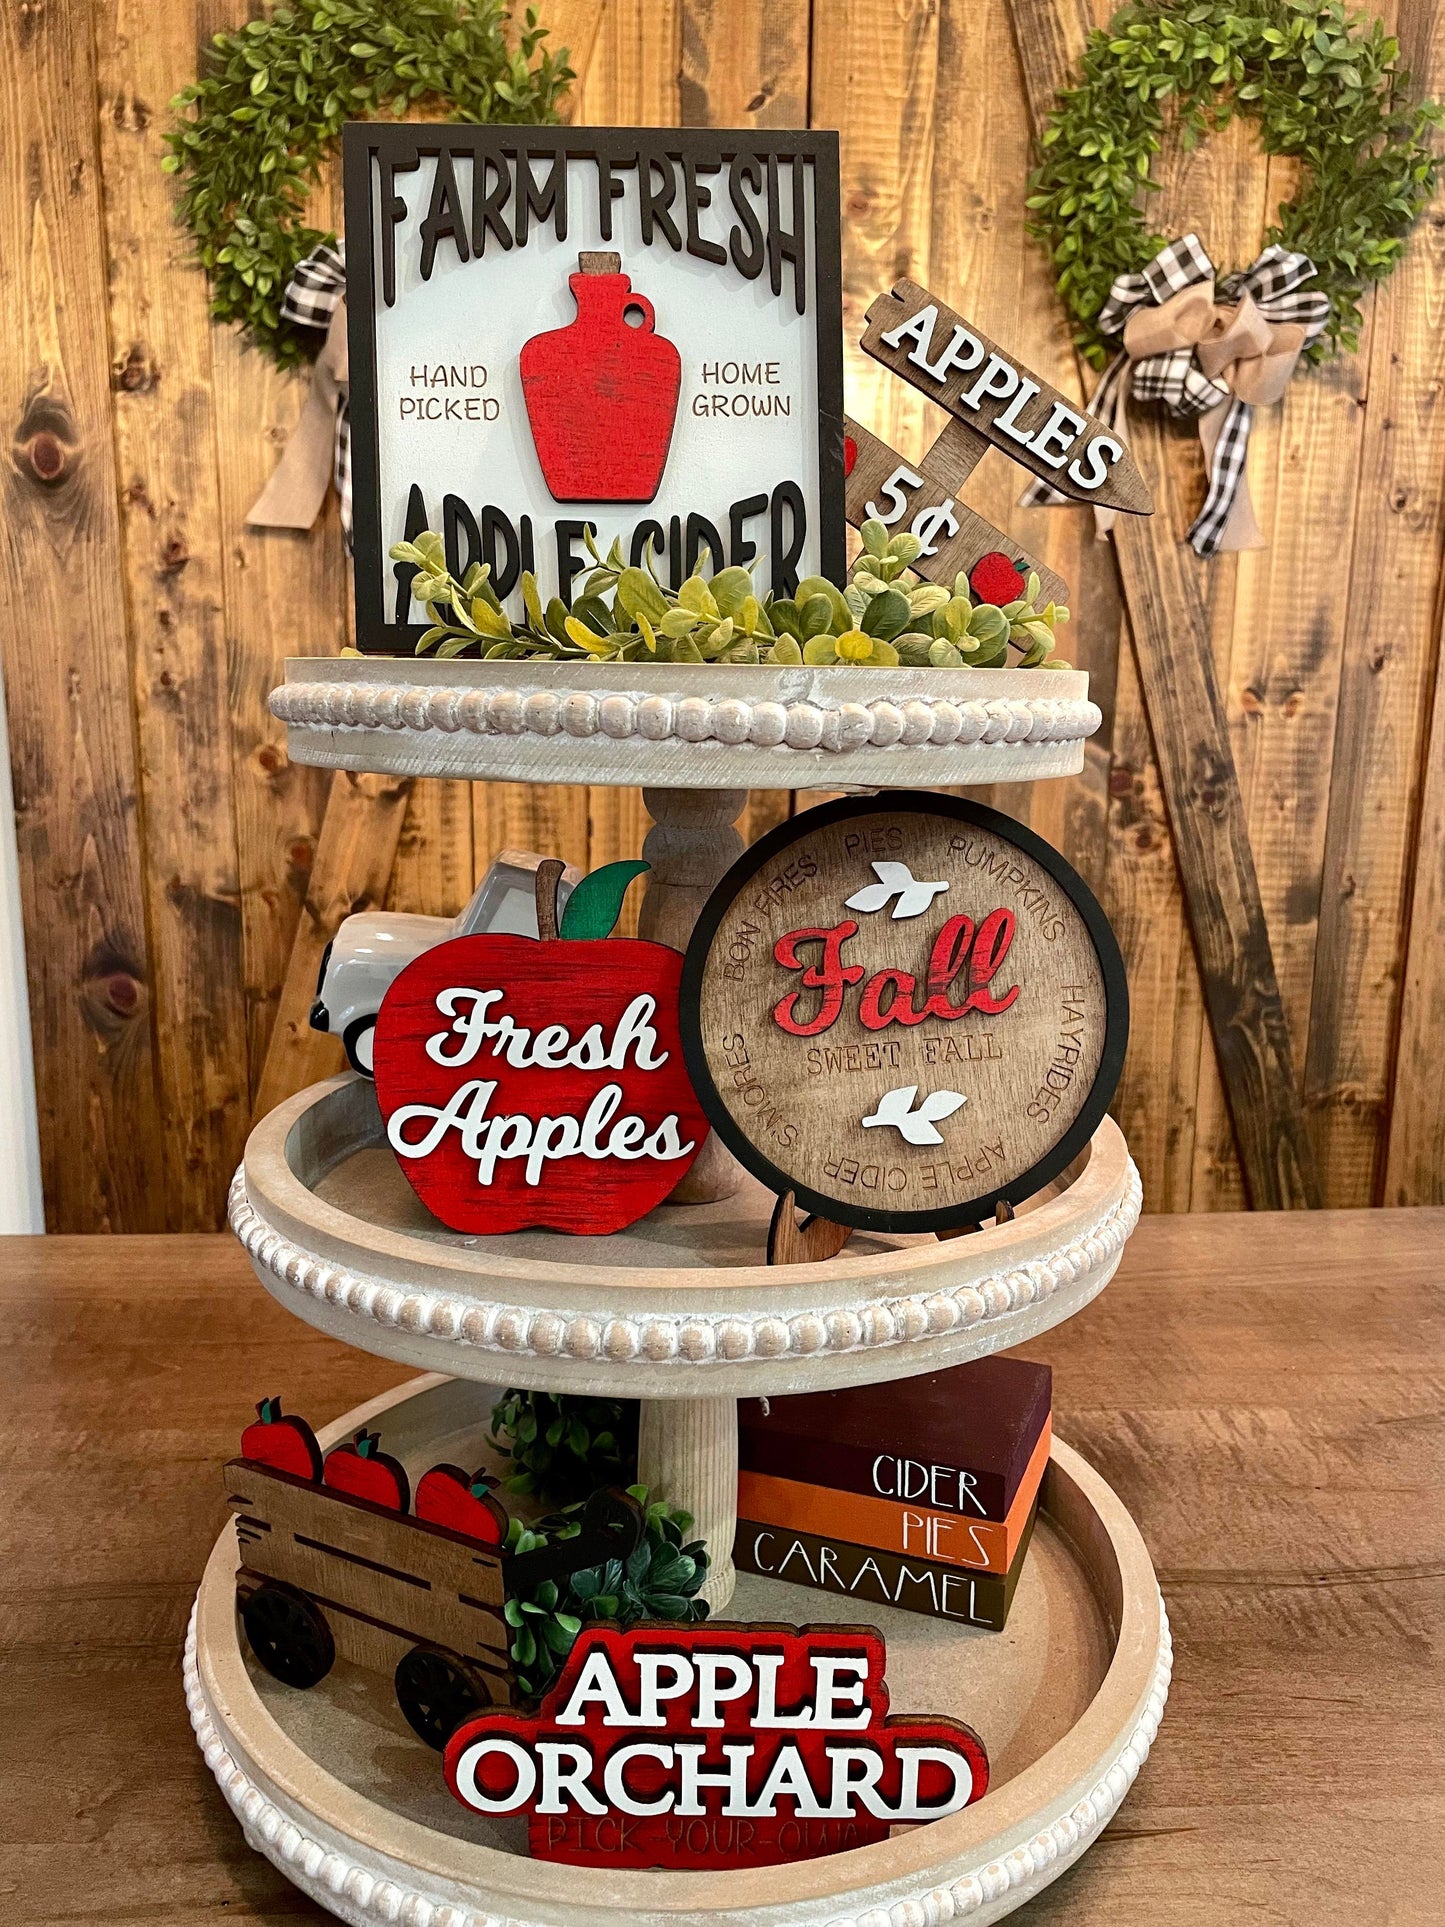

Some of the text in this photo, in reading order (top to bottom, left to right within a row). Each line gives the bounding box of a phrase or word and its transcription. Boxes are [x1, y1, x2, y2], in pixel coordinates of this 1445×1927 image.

[378, 149, 806, 315] FARM FRESH
[410, 364, 488, 389] HAND
[691, 393, 792, 418] GROWN
[701, 361, 781, 386] HOME
[880, 304, 1124, 490] APPLES
[399, 396, 501, 422] PICKED
[844, 826, 903, 858] PIES
[946, 834, 1066, 942] PUMPKINS
[722, 920, 761, 983] BON
[773, 907, 1020, 1037] Fall
[425, 987, 669, 1070] Fresh
[806, 1033, 1003, 1076] SWEET FALL
[1026, 984, 1085, 1124] HAYRIDES
[387, 1080, 696, 1186] Apples
[823, 1136, 1007, 1193] APPLE CIDER
[872, 1454, 987, 1516] CIDER
[902, 1511, 994, 1567] PIES
[754, 1532, 994, 1623] CARAMEL
[555, 1652, 873, 1730] APPLE
[456, 1739, 973, 1819] ORCHARD
